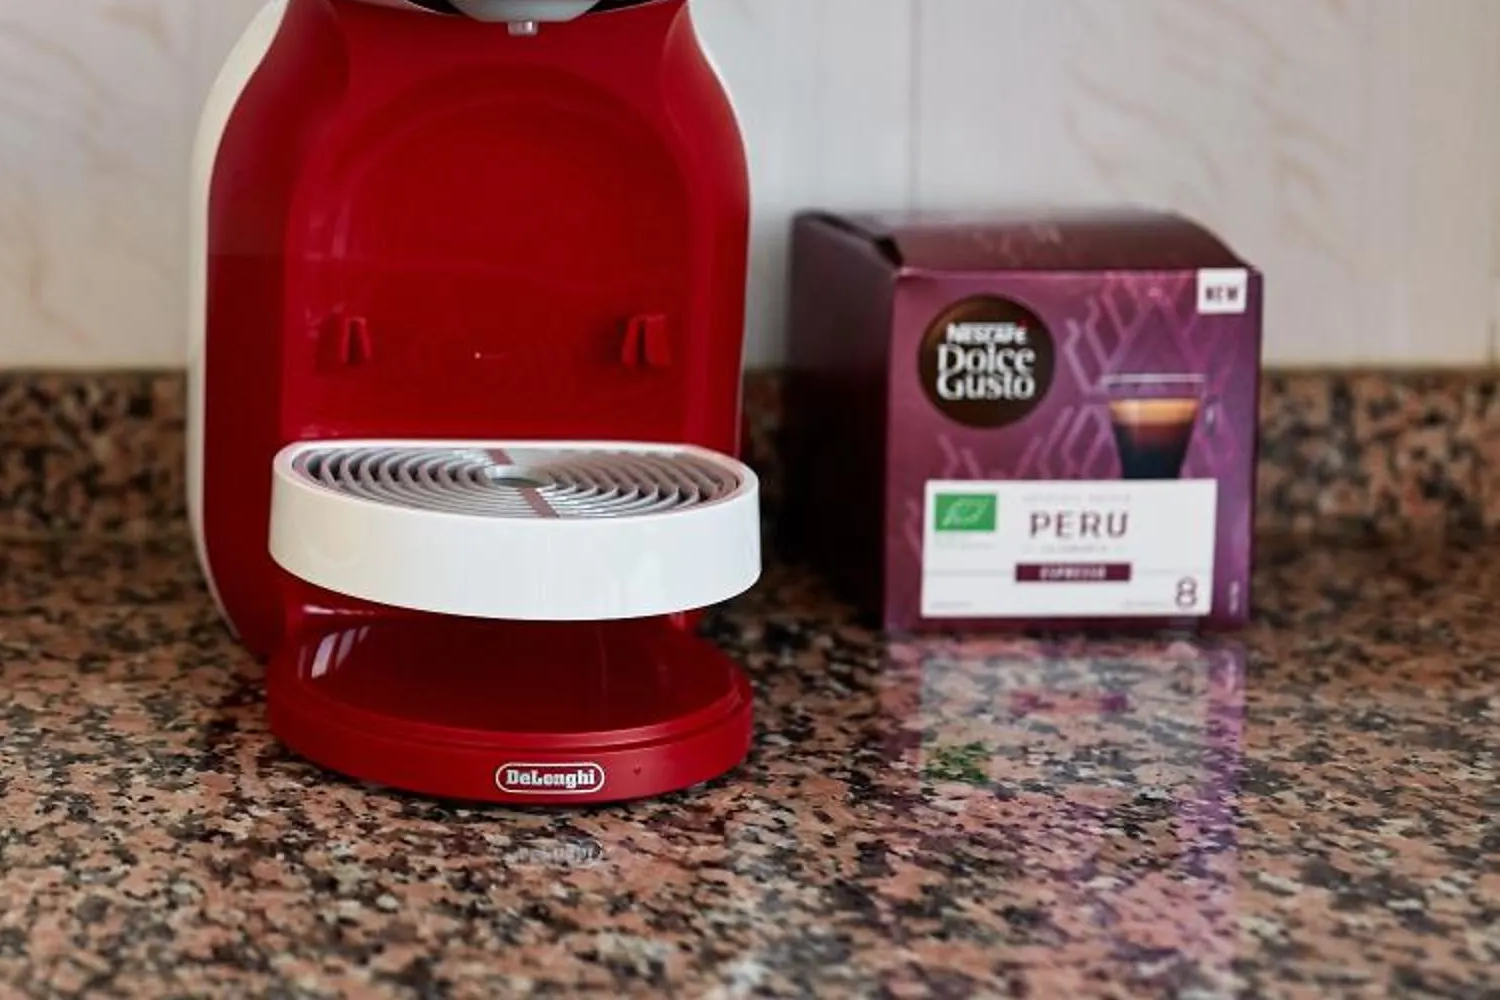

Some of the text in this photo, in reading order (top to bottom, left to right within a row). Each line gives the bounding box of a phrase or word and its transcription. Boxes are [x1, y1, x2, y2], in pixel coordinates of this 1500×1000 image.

[1205, 286, 1239, 302] NEW
[937, 343, 1036, 374] Dolce
[936, 370, 1036, 400] Gusto
[1029, 510, 1128, 539] PERU
[1174, 577, 1198, 608] 8
[505, 768, 596, 789] DeLonghi
